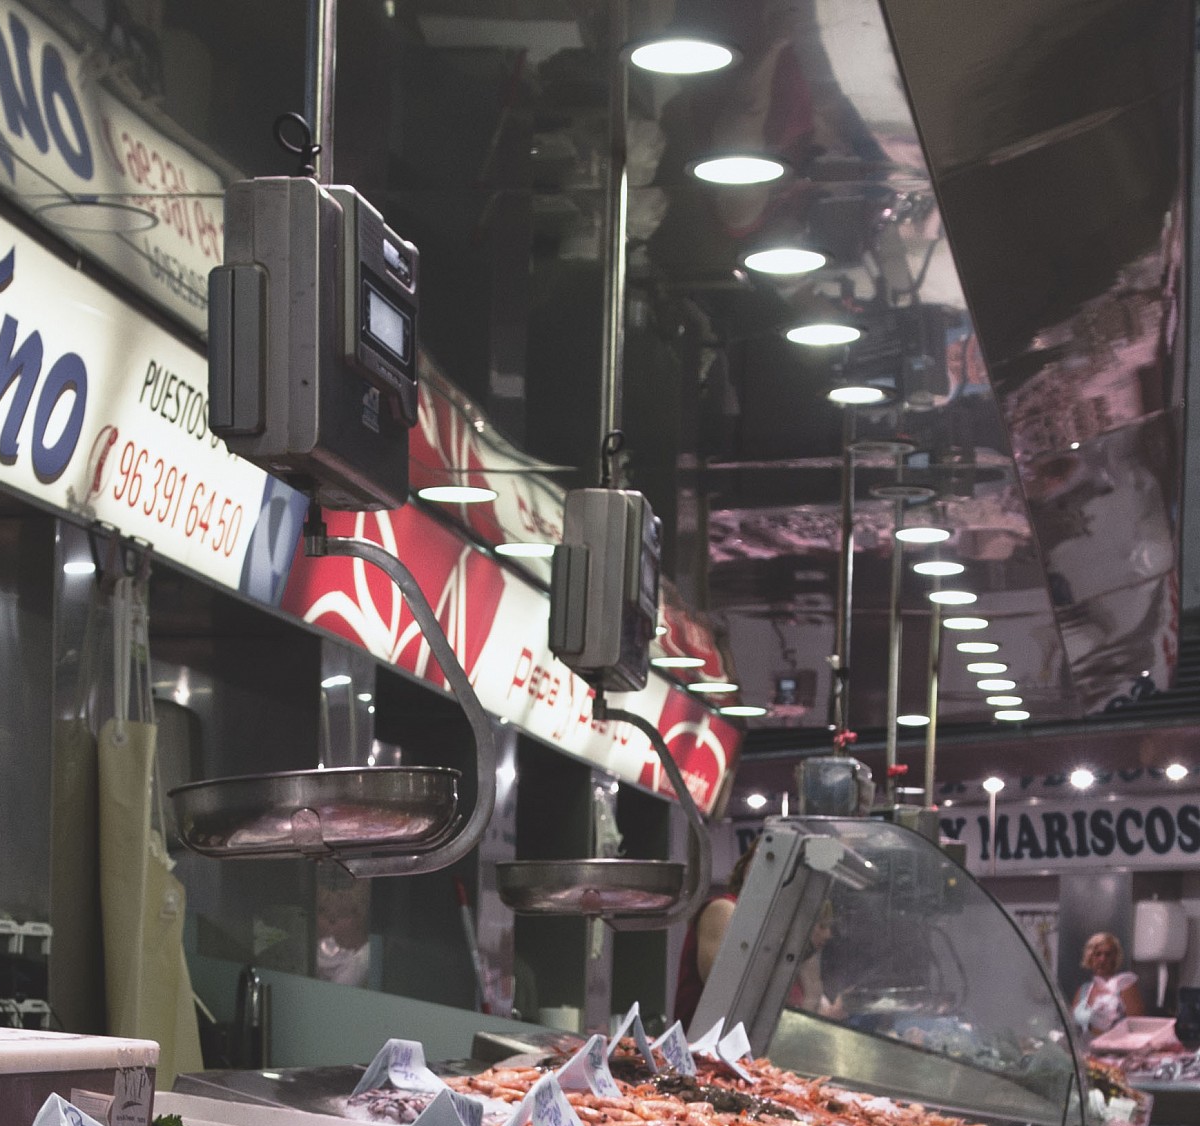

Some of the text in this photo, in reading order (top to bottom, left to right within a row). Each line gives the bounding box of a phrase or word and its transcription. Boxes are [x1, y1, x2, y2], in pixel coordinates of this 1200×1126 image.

[139, 358, 210, 441] PUESTOS
[113, 440, 149, 508] 96
[143, 457, 188, 529] 391
[184, 482, 217, 545] 64
[211, 498, 243, 558] 50
[979, 804, 1200, 861] MARISCOS
